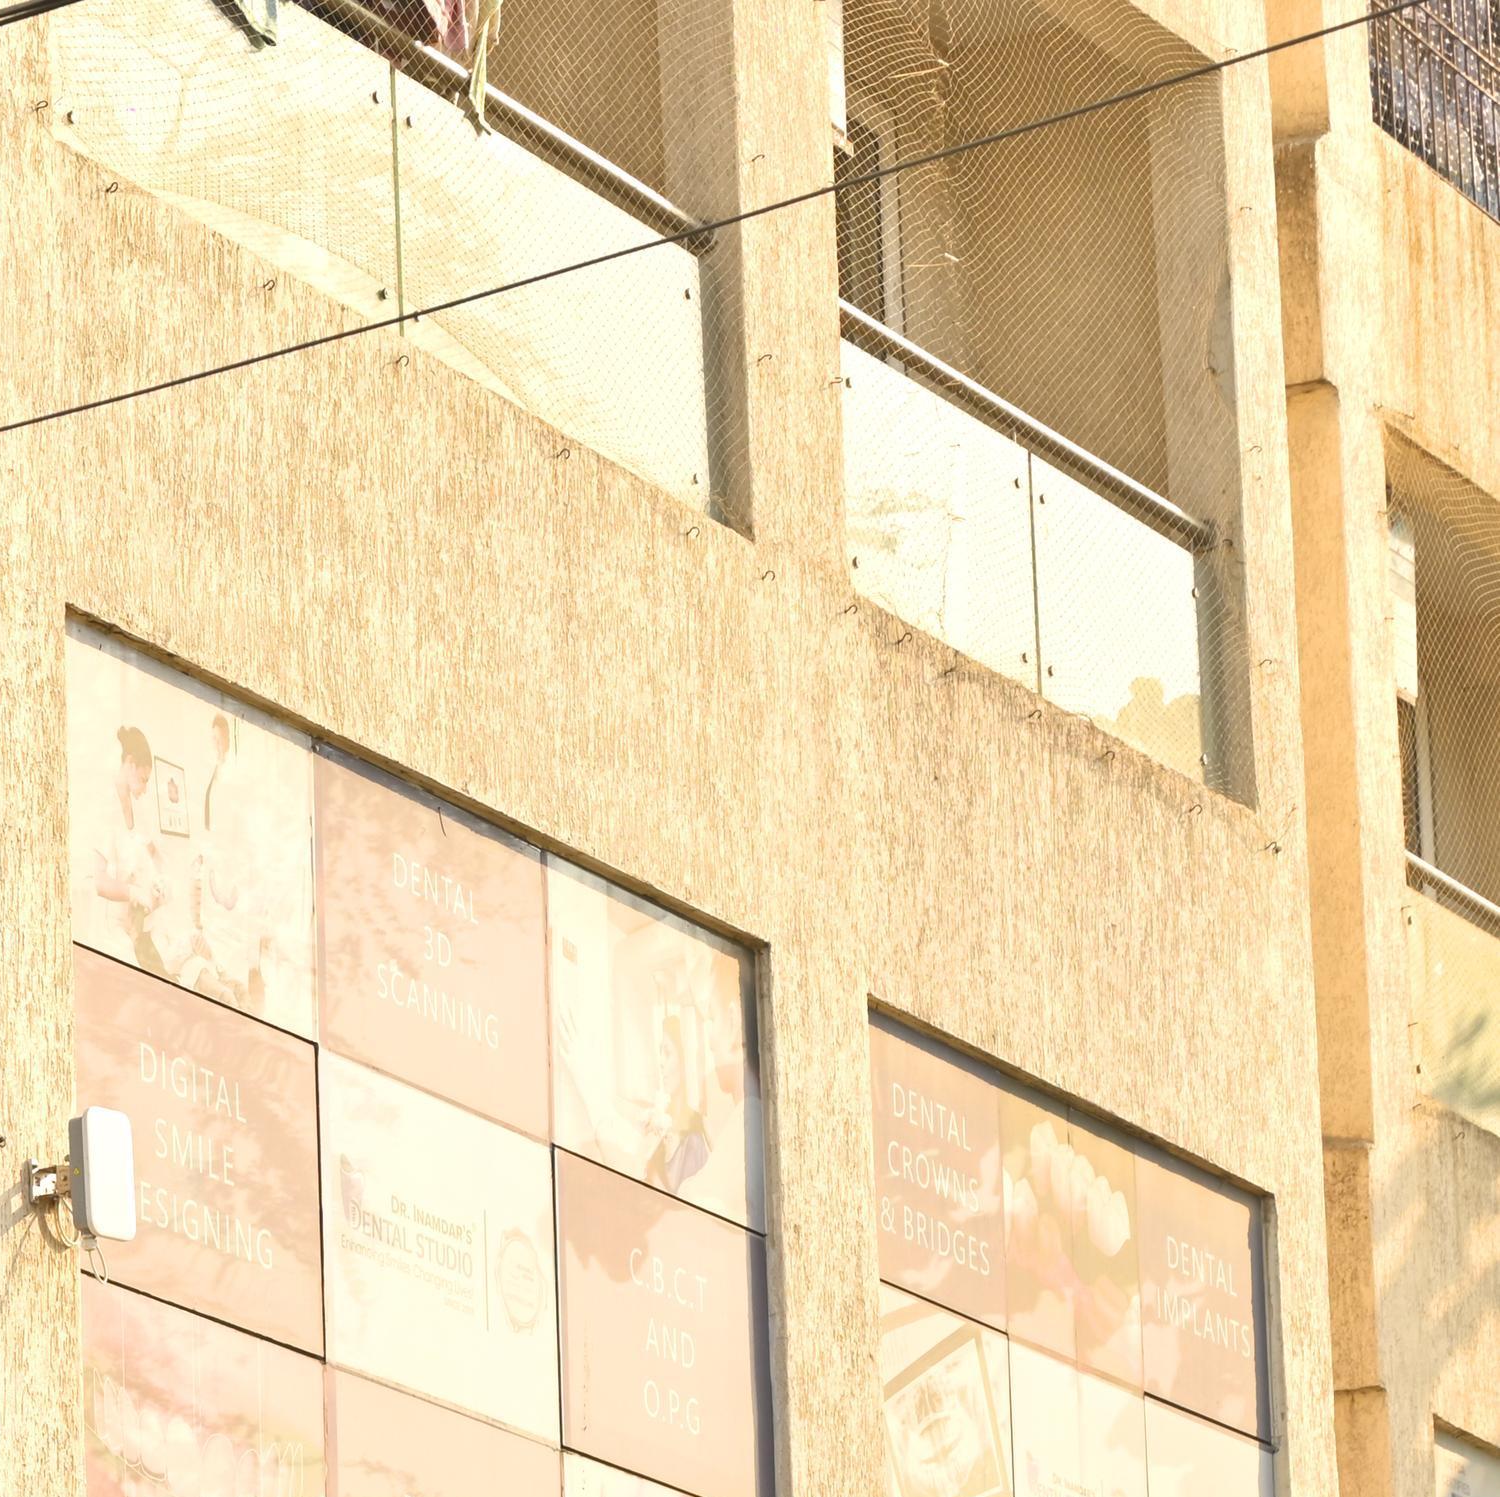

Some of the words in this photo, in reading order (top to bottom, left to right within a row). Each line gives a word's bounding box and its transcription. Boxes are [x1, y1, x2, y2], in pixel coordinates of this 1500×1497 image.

[392, 851, 479, 925] DENTAL
[423, 927, 453, 968] 3D
[377, 963, 499, 1049] SCANNING
[139, 1041, 247, 1125] DIGITAL
[154, 1117, 236, 1188] SMILE
[886, 1140, 980, 1213] CROWNS
[138, 1189, 273, 1270] ESIGNING
[902, 1207, 990, 1277] BRIDGES
[1165, 1234, 1238, 1298] DENTAL
[646, 1324, 695, 1369] AND
[1156, 1281, 1252, 1359] IMPLANTS
[643, 1380, 701, 1437] O.P.G
